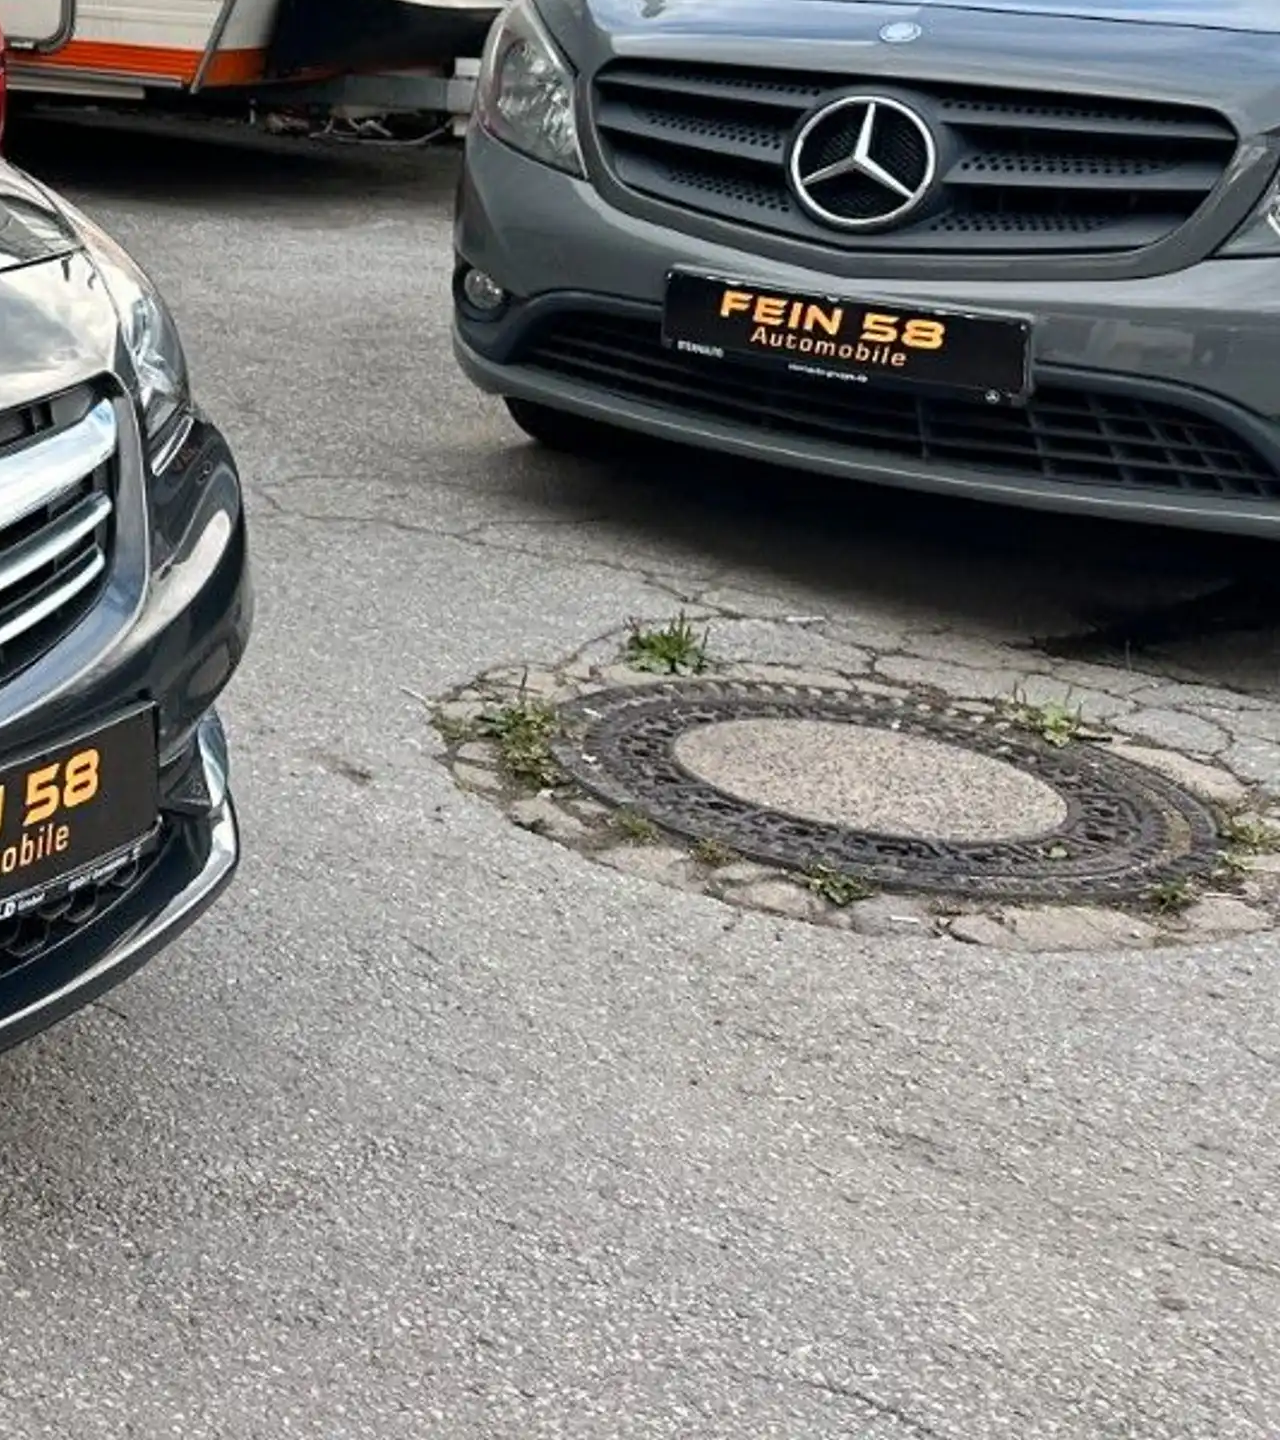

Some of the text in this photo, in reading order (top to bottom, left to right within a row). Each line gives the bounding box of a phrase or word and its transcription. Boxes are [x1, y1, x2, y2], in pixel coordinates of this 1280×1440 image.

[720, 289, 947, 351] FEIN 58
[749, 326, 908, 368] Automobile
[23, 748, 100, 826] 58
